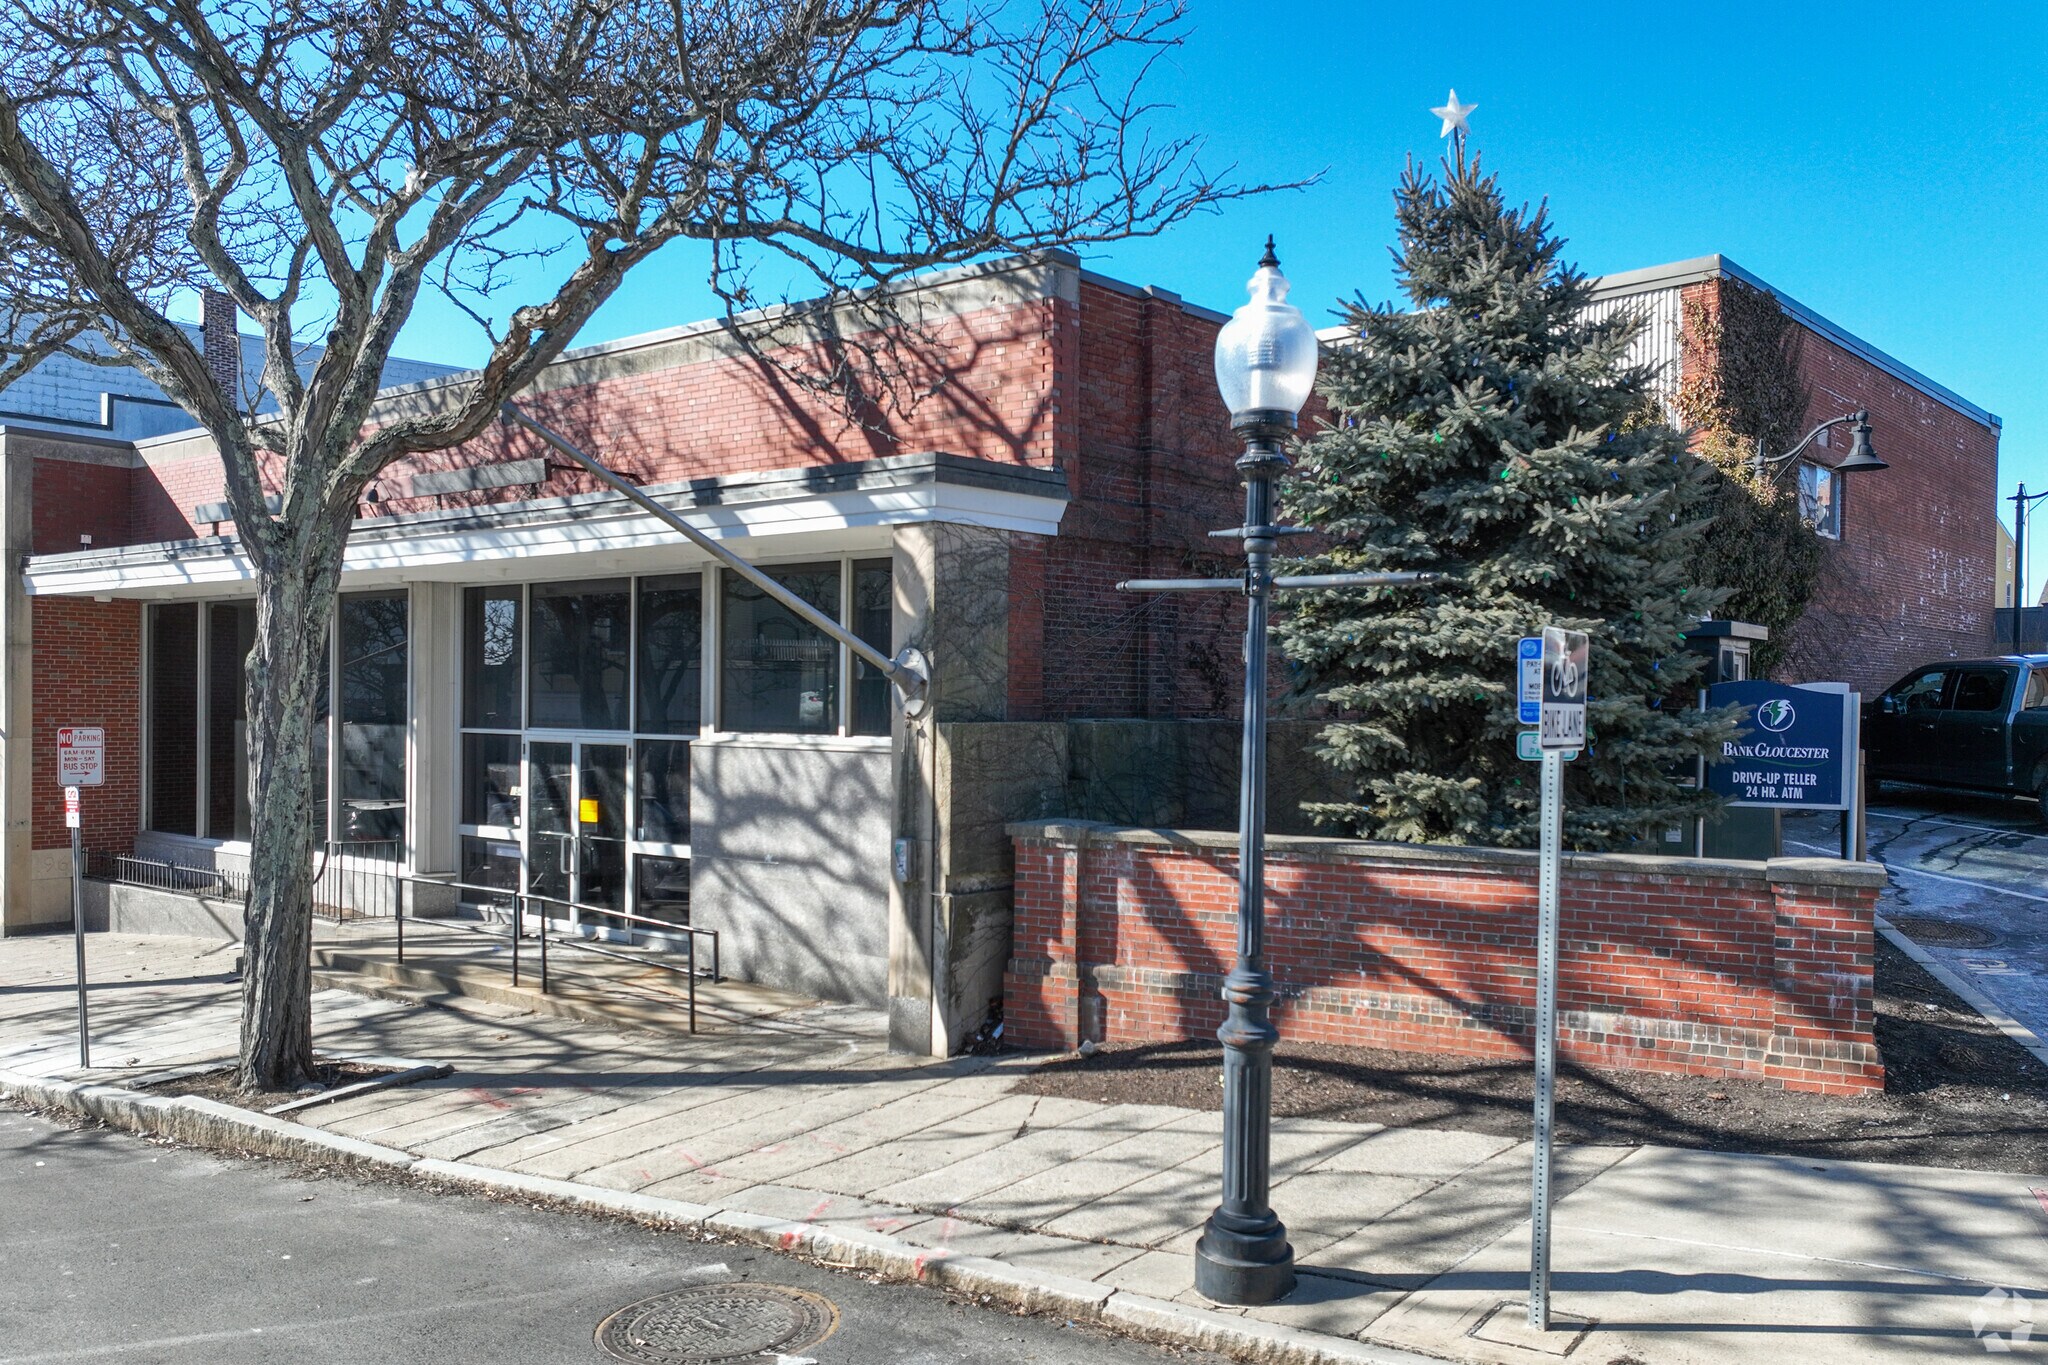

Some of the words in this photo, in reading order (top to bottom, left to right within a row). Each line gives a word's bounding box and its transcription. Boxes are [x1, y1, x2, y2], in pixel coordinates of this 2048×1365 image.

[1544, 710, 1560, 738] BIKE
[1562, 710, 1582, 738] LANE
[60, 733, 72, 744] NO
[73, 734, 101, 742] PARKING
[63, 762, 78, 770] BUS
[80, 762, 98, 770] STOP
[1732, 771, 1781, 784] DRIVE-UP
[1783, 773, 1817, 786] TELLER
[1746, 786, 1758, 797] 24
[1761, 786, 1779, 798] HR.
[1781, 787, 1803, 799] ATM
